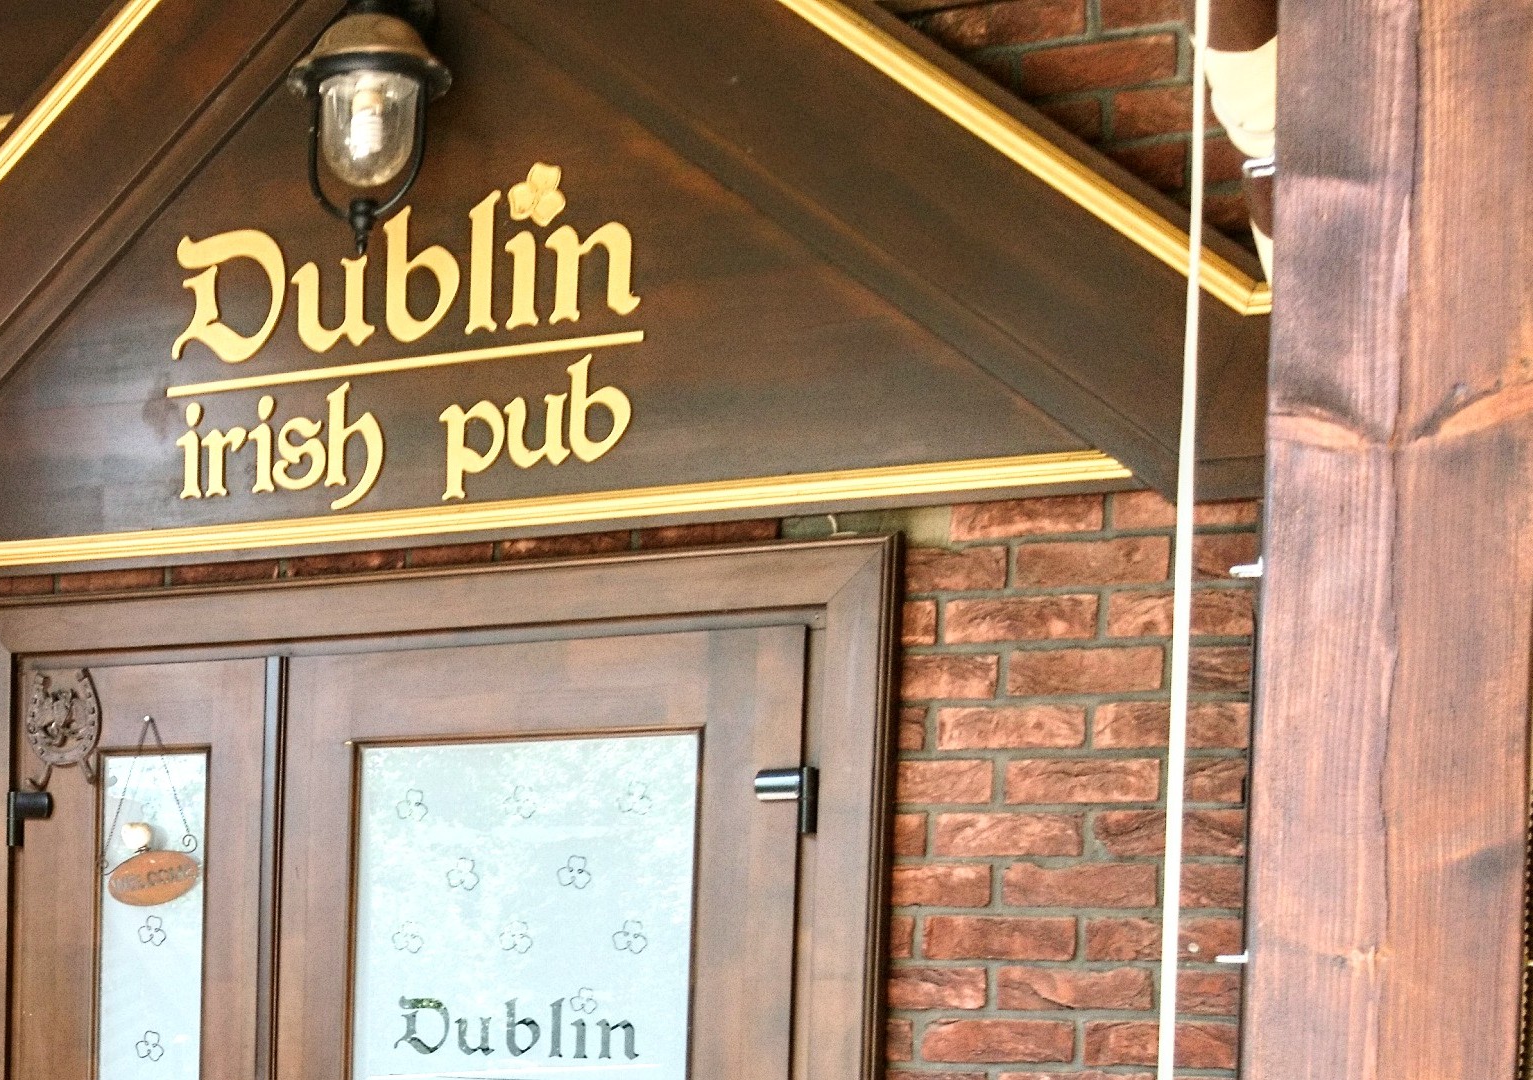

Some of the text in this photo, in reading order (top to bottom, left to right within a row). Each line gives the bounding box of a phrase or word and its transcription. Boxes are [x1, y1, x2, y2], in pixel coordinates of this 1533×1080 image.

[171, 162, 641, 364] Dublin
[175, 353, 633, 510] irish pub
[393, 987, 640, 1061] Dublin
